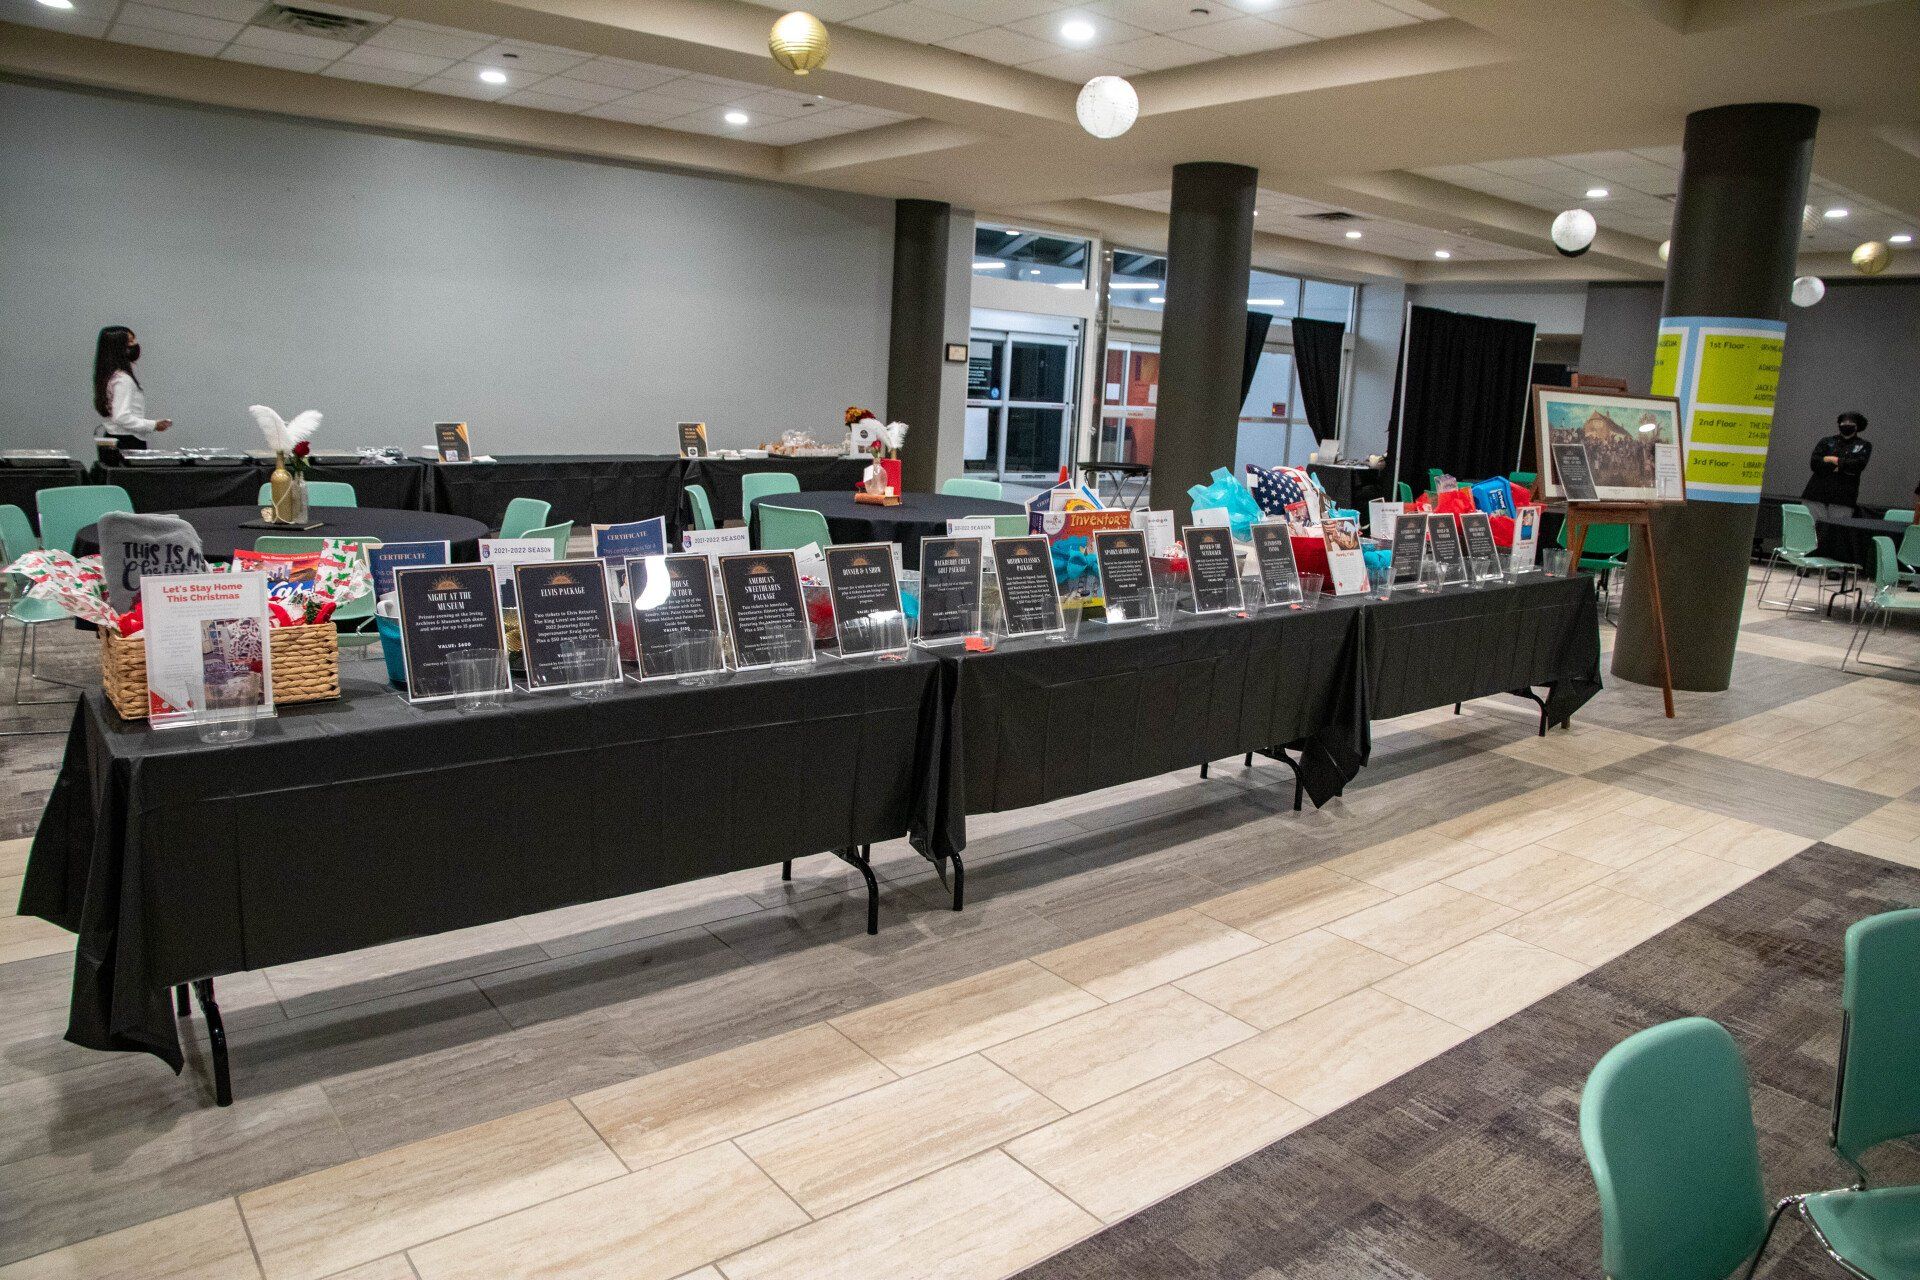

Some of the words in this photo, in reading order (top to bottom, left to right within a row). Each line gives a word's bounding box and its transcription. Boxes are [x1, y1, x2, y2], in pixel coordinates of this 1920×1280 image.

[1723, 342, 1745, 350] Floor
[1699, 418, 1714, 427] 2nd
[1716, 420, 1737, 428] Floor
[1693, 457, 1707, 466] 3rd
[1709, 459, 1731, 468] Floor
[607, 531, 648, 541] CERTIFICATE
[721, 534, 745, 542] SEASON
[165, 543, 184, 565] IS
[379, 552, 426, 561] CERTIFICATE
[749, 576, 775, 585] AMERICA'S
[163, 585, 187, 594] Let's
[190, 584, 212, 593] Stay
[213, 583, 243, 591] Home
[541, 588, 558, 597] ELVIS
[559, 587, 586, 596] PACKAGE
[678, 589, 693, 597] TOUR
[744, 584, 781, 593] SWEETHEARTS
[167, 594, 188, 603] This
[190, 593, 240, 601] Christmas
[427, 593, 447, 602] NIGHT
[449, 592, 458, 601] AT
[459, 591, 472, 600] THE
[753, 593, 777, 601] PACKAGE
[437, 601, 465, 611] MUSEUM
[557, 622, 579, 630] featuring
